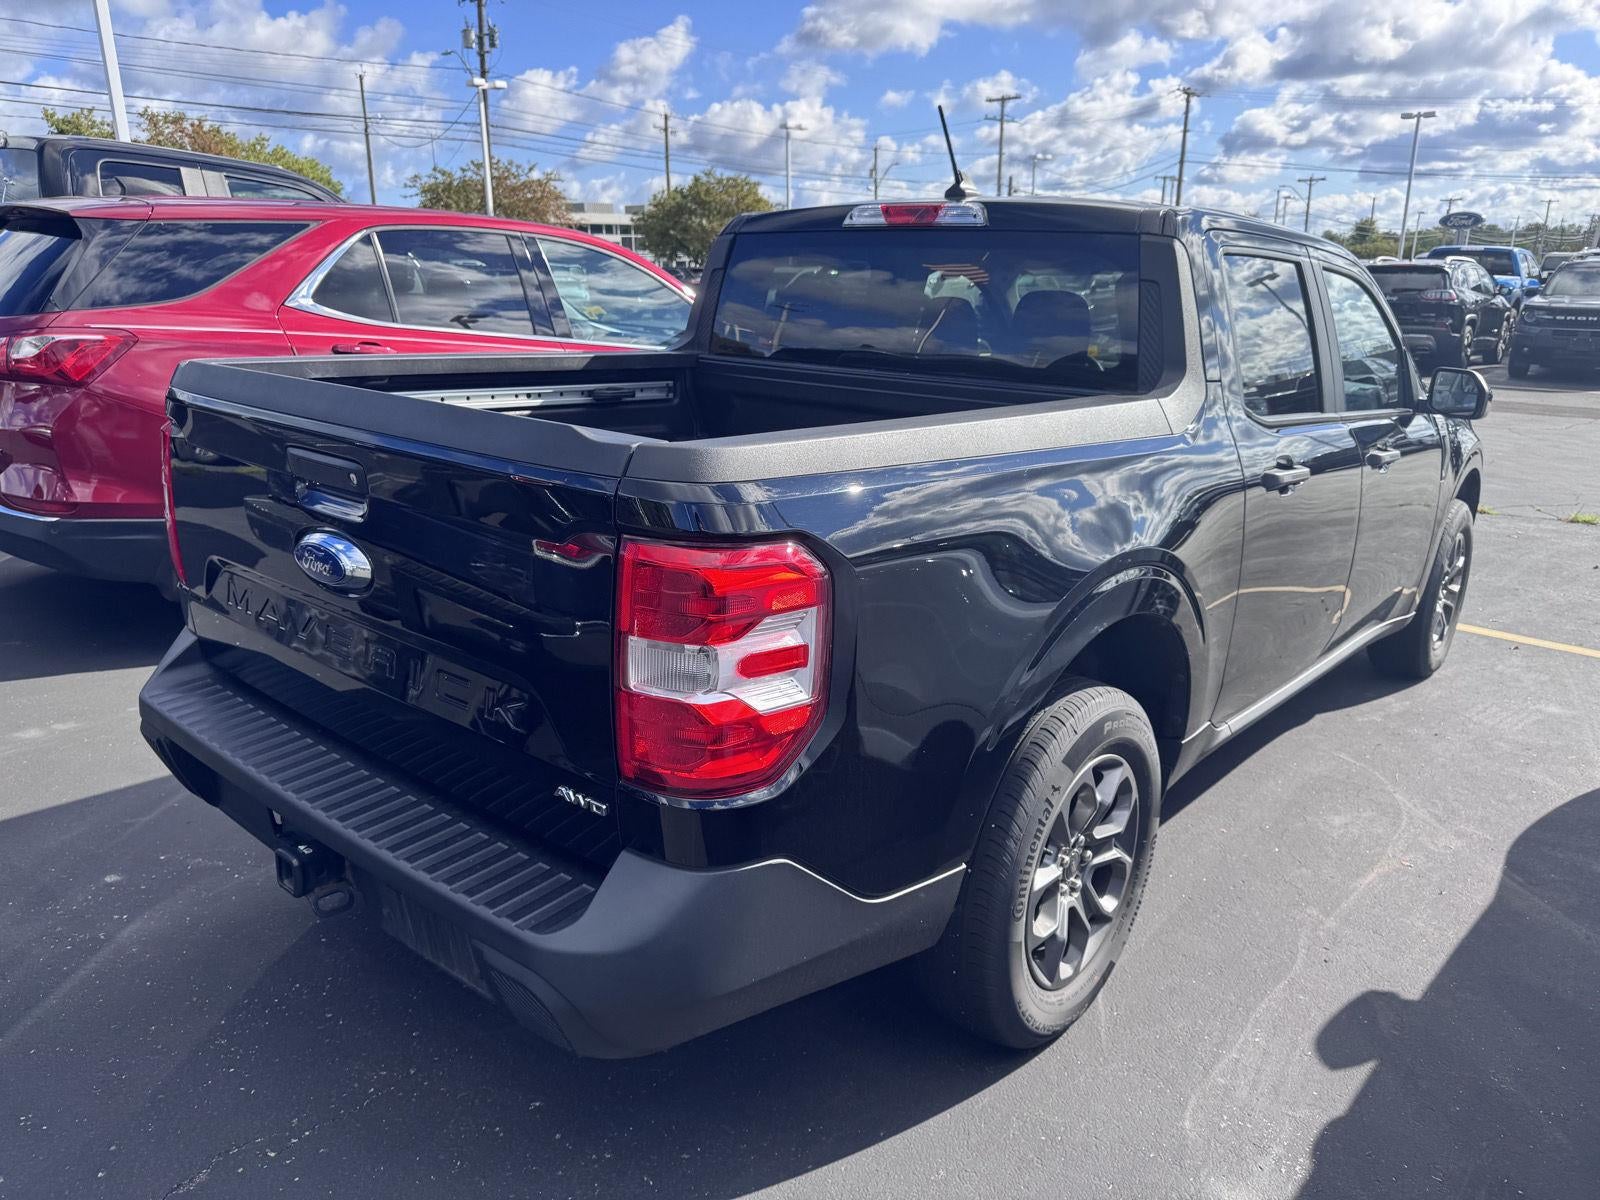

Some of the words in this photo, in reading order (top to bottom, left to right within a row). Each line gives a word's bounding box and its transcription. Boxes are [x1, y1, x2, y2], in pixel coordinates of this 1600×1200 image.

[302, 546, 334, 577] Ford
[226, 574, 528, 735] MAVERICK
[553, 786, 609, 816] AWD
[1011, 797, 1055, 923] Continental
